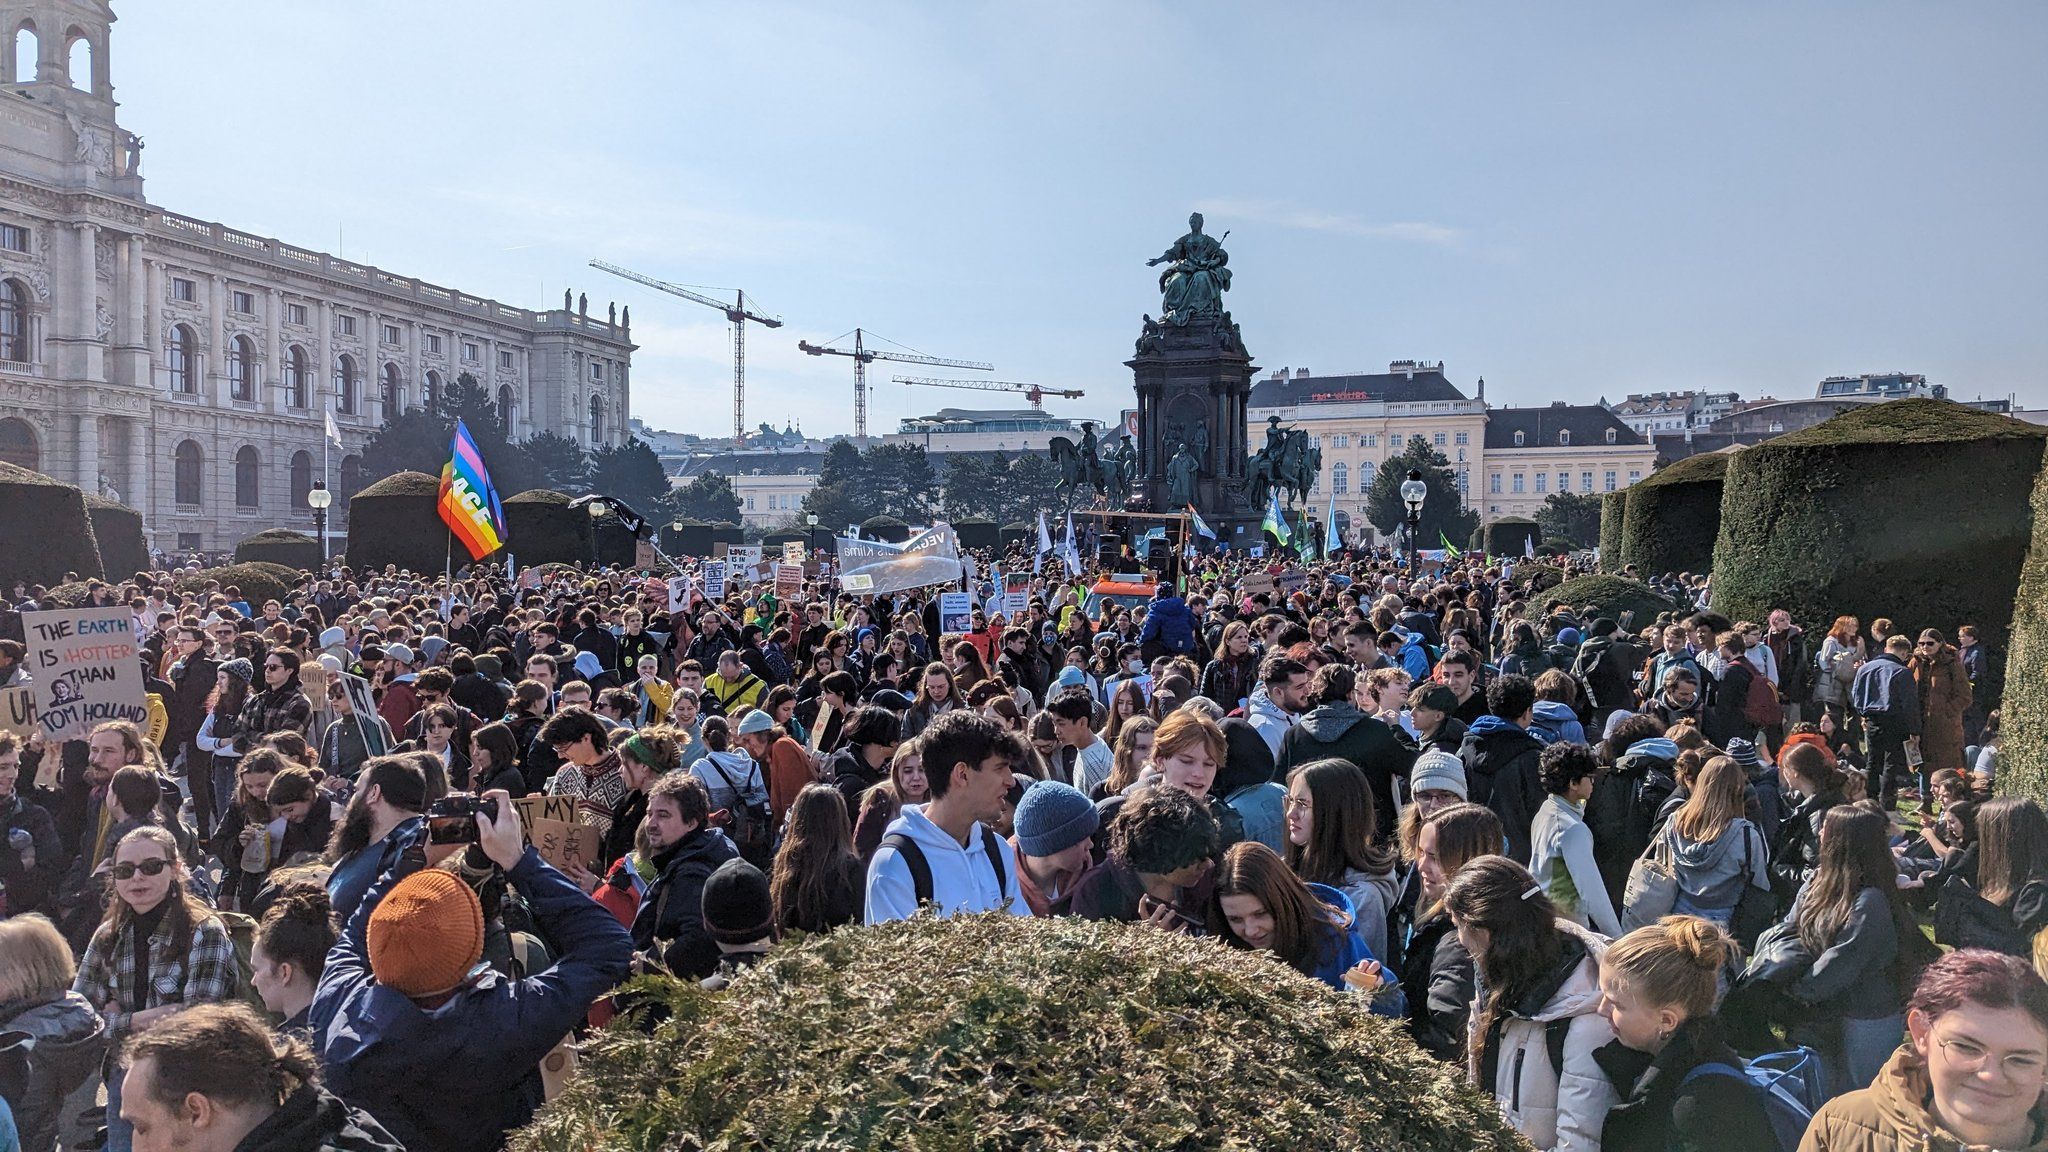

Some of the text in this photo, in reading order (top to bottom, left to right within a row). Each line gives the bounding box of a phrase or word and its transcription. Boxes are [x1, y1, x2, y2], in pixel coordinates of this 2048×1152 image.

[33, 619, 128, 641] THE EARTH
[39, 644, 130, 668] IS HOTTER
[61, 666, 115, 684] THAN
[37, 702, 147, 732] TOM HOLLAND
[544, 797, 576, 823] MY
